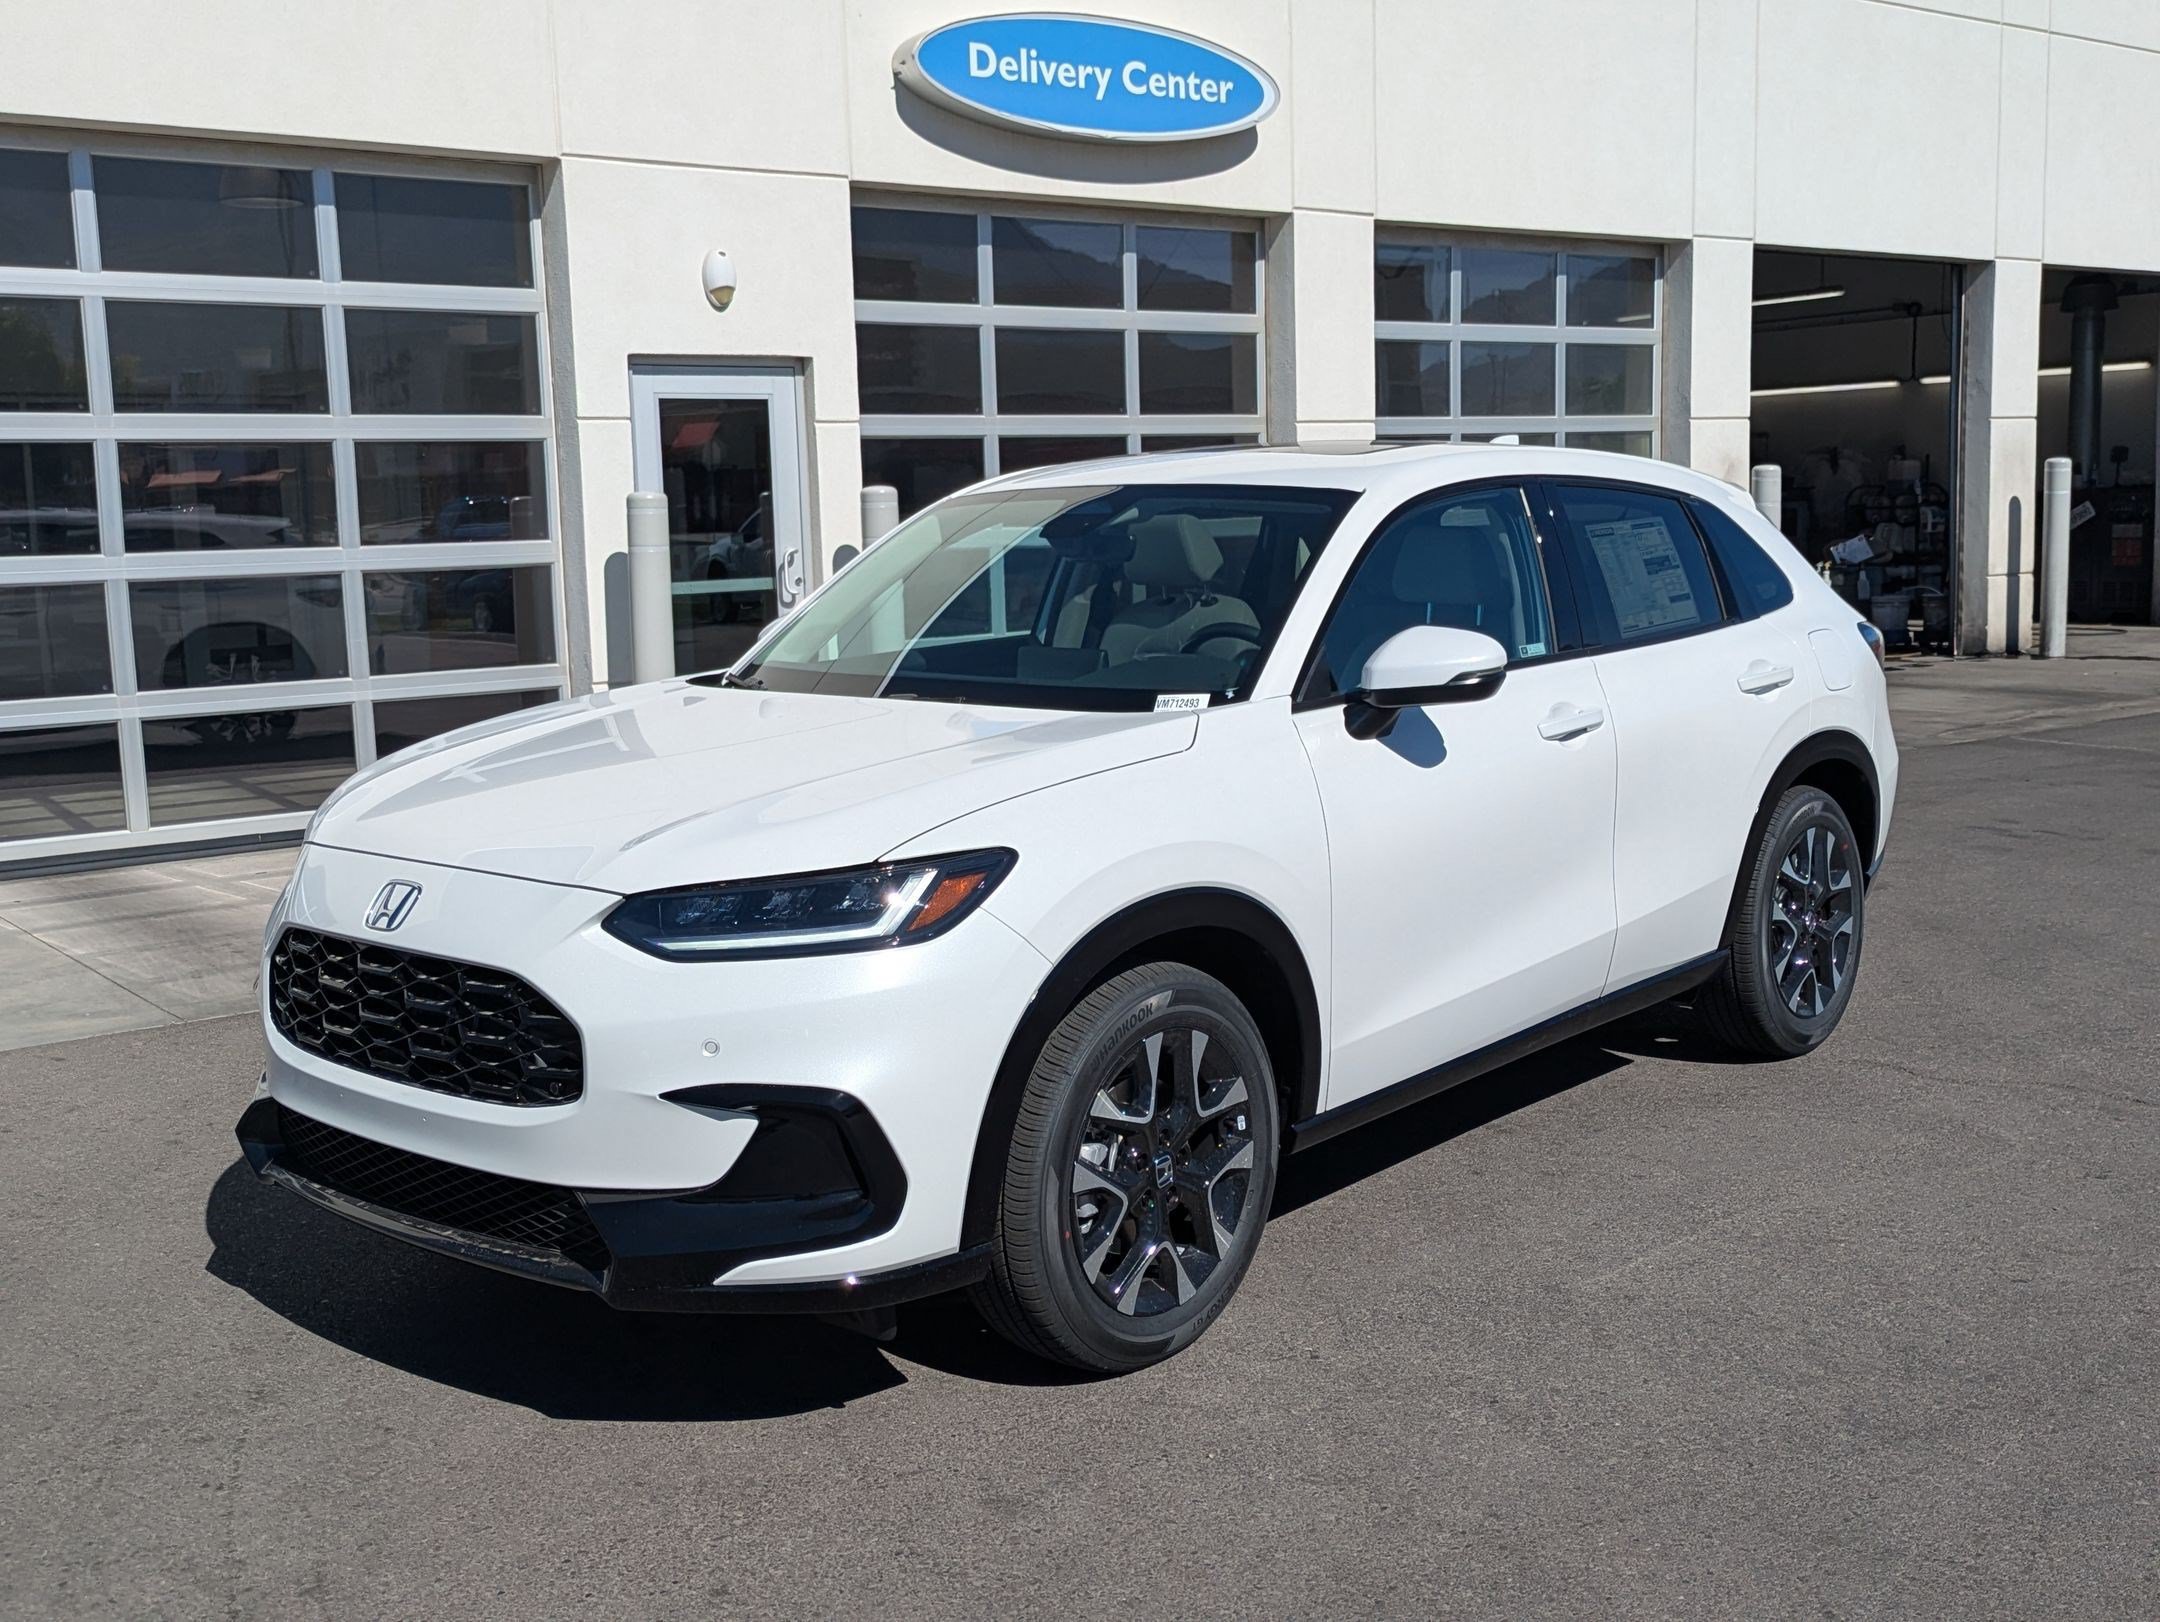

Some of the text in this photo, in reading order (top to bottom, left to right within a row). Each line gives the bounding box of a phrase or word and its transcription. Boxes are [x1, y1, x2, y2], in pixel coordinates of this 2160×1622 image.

[968, 41, 1234, 104] Delivery Center
[1156, 698, 1200, 709] VM712493
